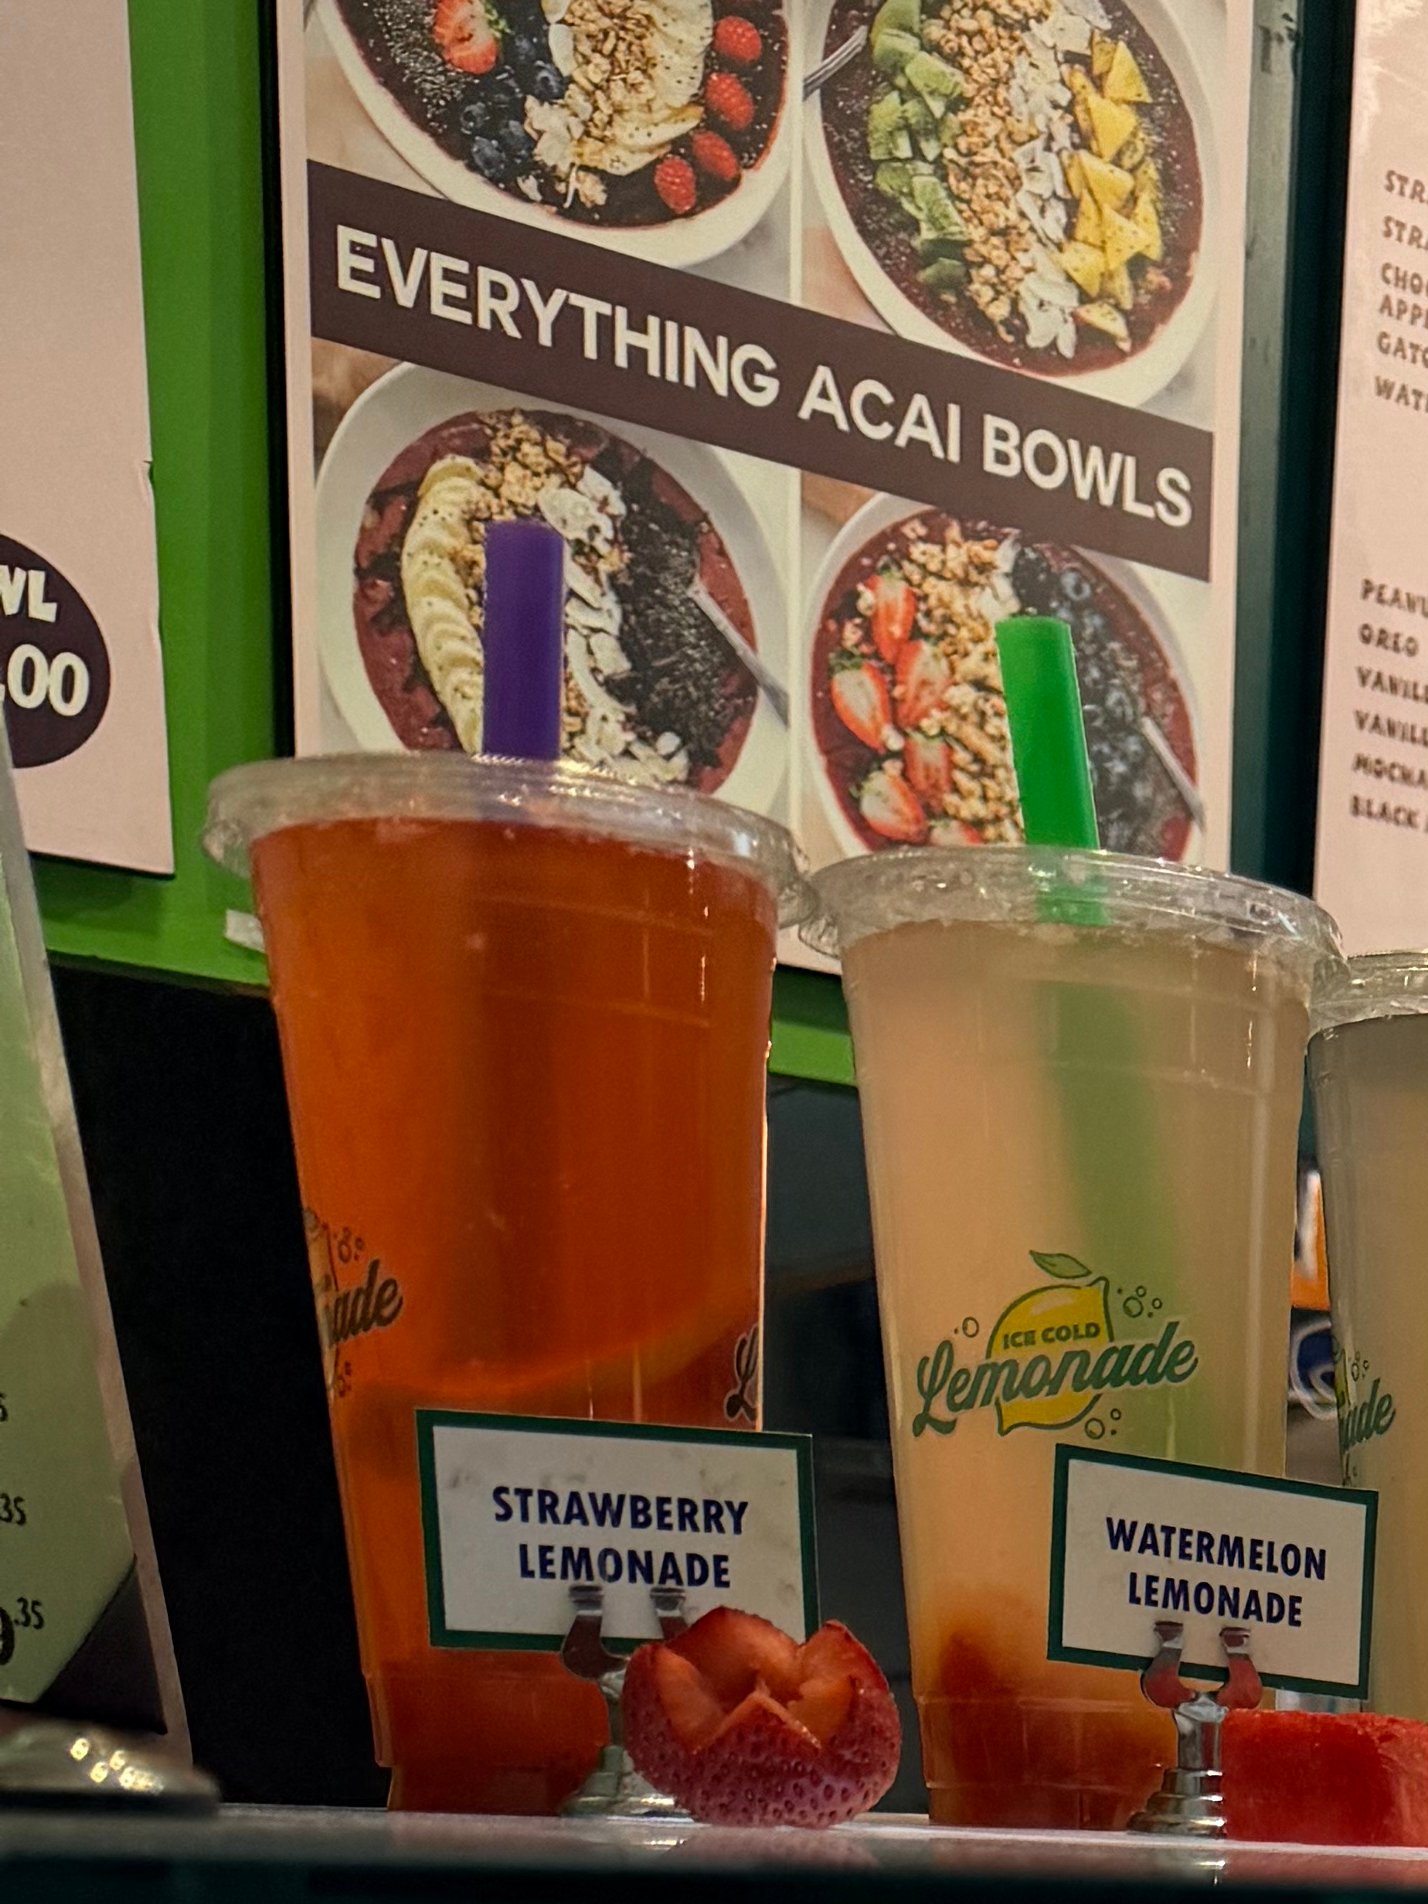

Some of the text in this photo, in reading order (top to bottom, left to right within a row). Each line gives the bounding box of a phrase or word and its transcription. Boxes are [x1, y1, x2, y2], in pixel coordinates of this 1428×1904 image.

[333, 223, 1193, 530] EVERYTHING ACAI BOWLS
[1359, 623, 1418, 657] OREO
[1003, 1322, 1100, 1349] ICE COLD
[913, 1321, 1198, 1438] Lemonade
[492, 1486, 748, 1536] STRAWBERRY
[519, 1543, 731, 1588] LEMONADE
[1106, 1516, 1326, 1581] WATERMELON
[1128, 1573, 1303, 1628] LEMONADE
